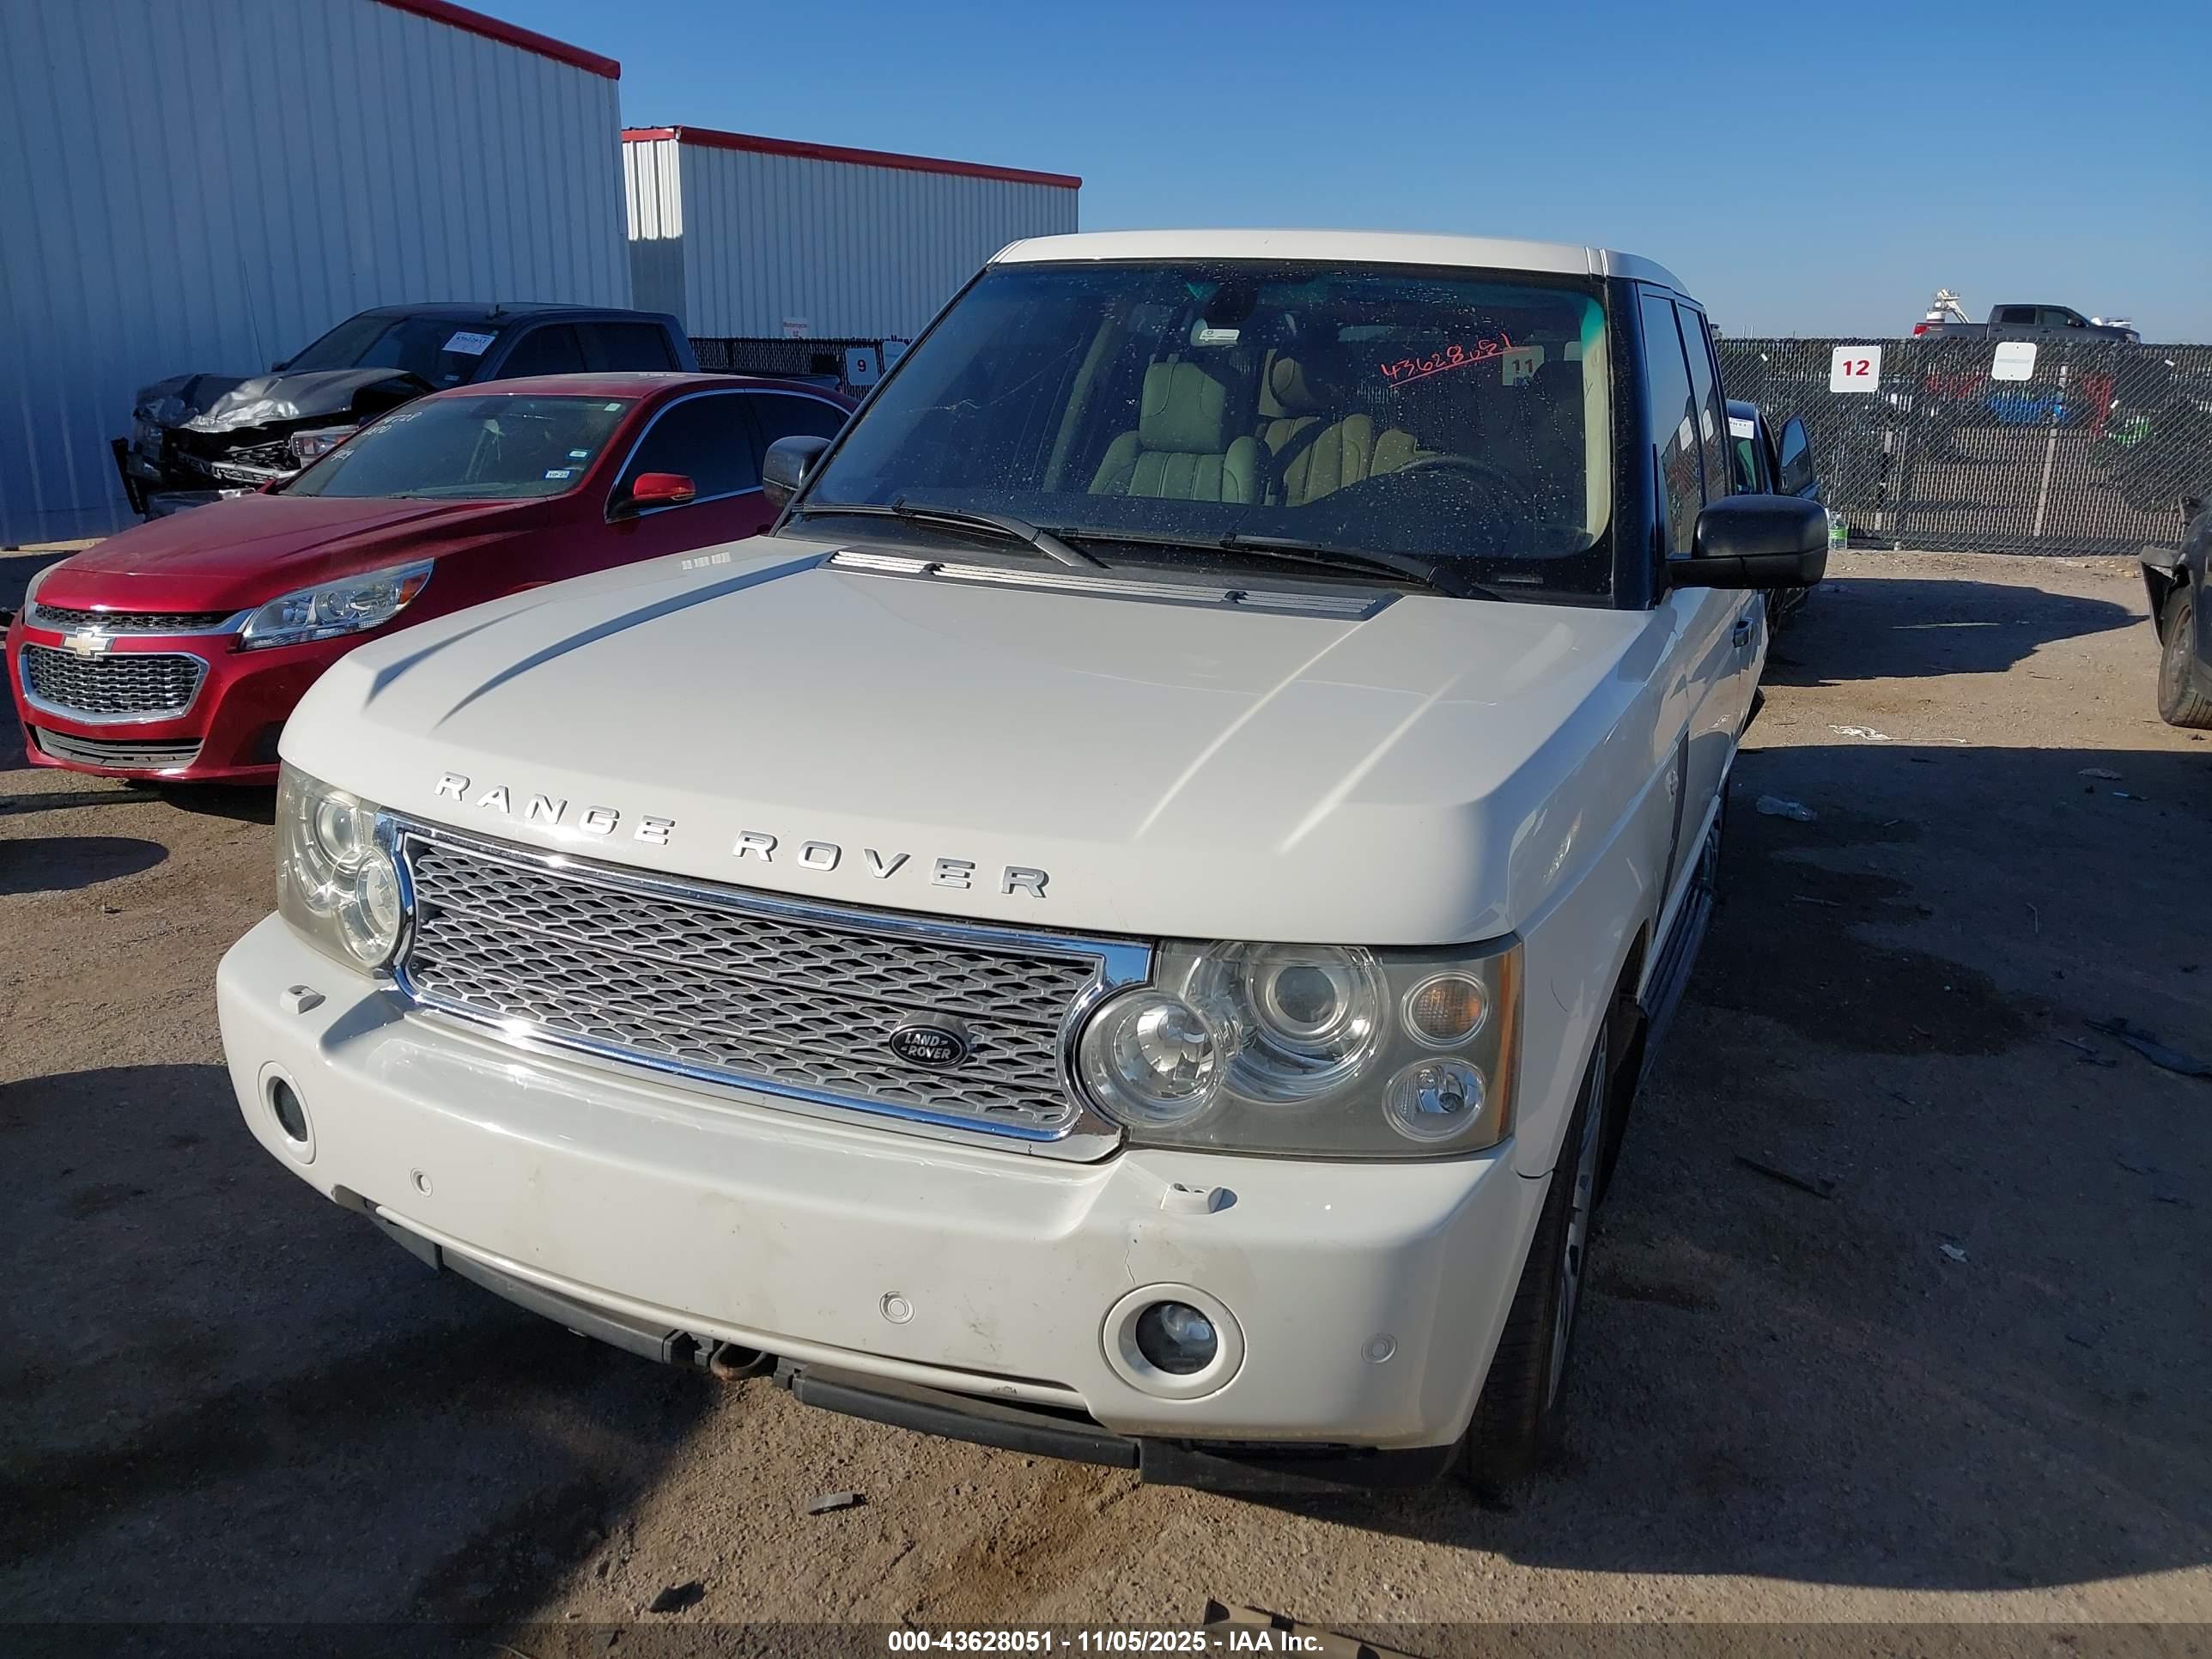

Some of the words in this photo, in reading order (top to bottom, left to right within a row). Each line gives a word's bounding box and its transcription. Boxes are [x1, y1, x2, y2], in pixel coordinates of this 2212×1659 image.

[857, 359, 866, 372] 9
[1512, 359, 1534, 374] 11
[1843, 360, 1870, 376] 12
[433, 771, 676, 845] RANGE
[732, 830, 1049, 898] ROVER
[904, 1032, 939, 1047] LAND
[907, 1045, 951, 1060] ROVER
